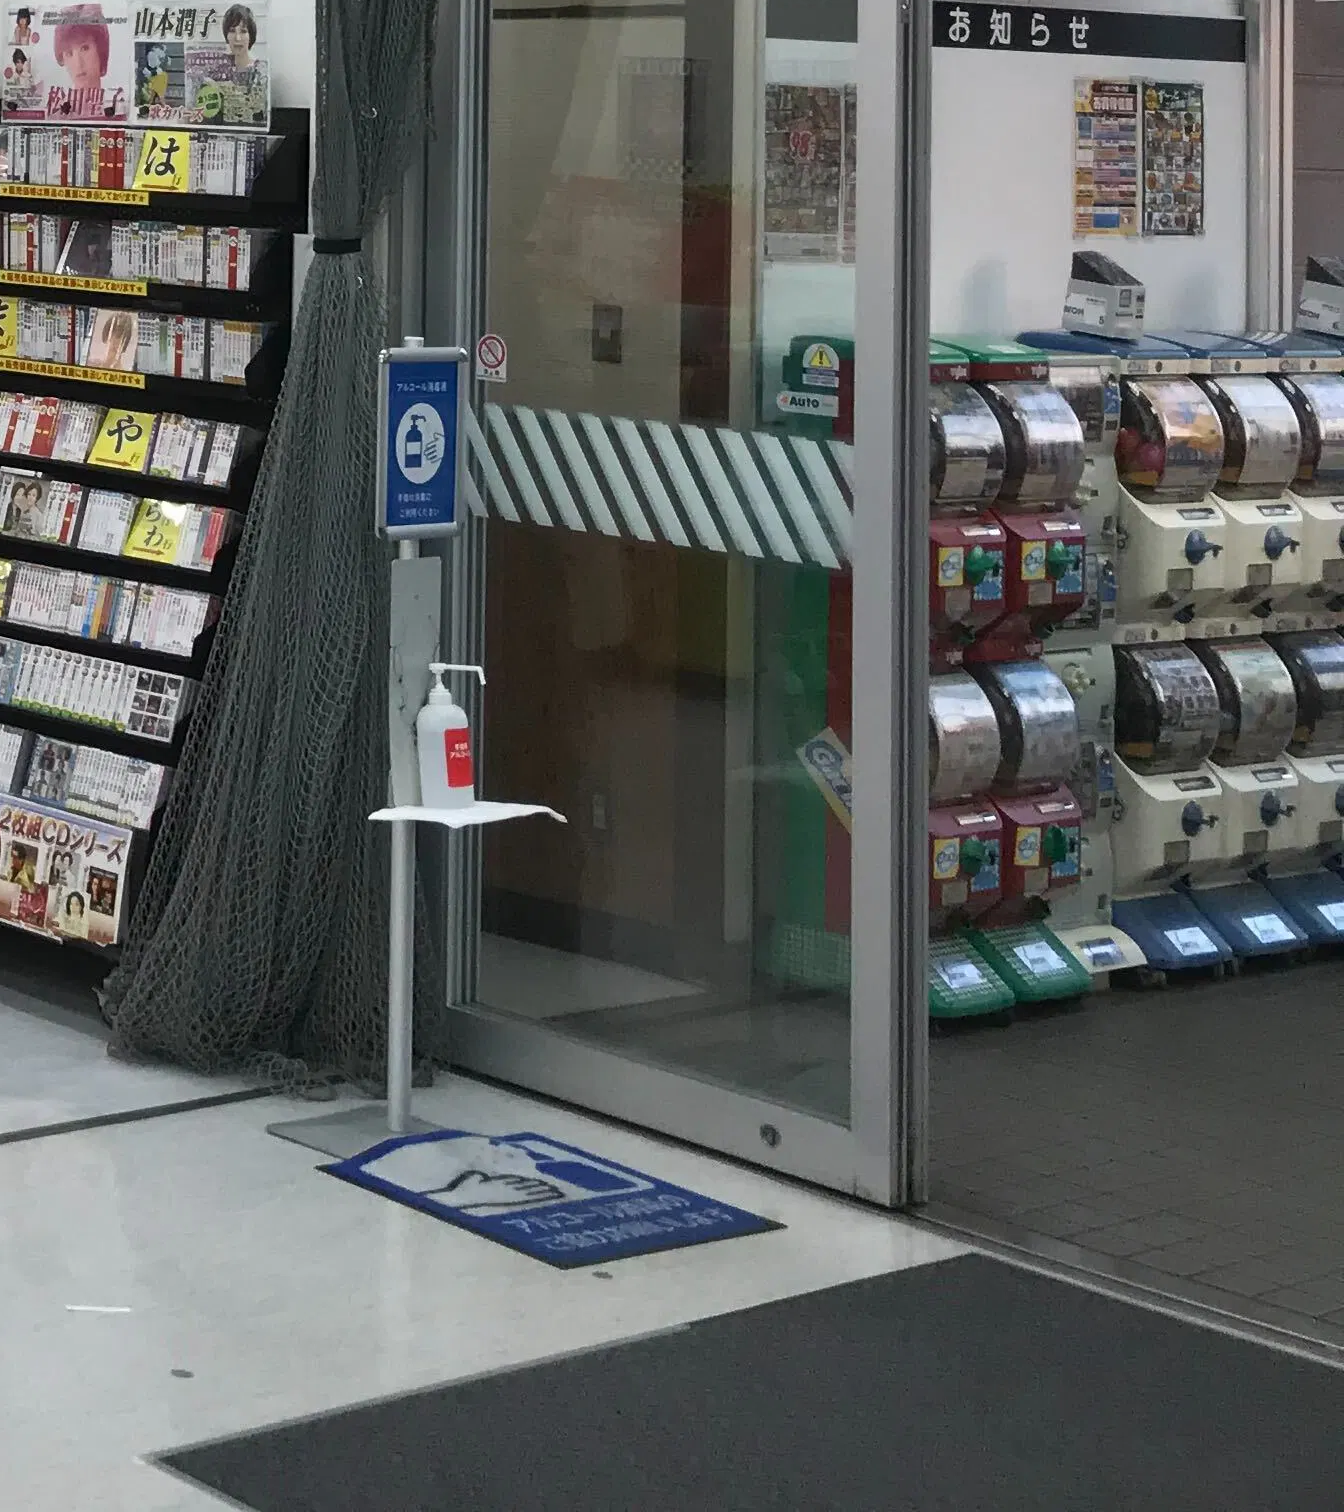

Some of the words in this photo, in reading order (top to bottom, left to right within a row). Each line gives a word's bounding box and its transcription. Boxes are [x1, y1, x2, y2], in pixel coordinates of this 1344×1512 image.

[134, 7, 218, 38] 山本潤子
[947, 6, 1090, 49] お知らせ
[144, 137, 180, 176] は
[789, 396, 820, 409] Auto
[107, 414, 143, 454] や
